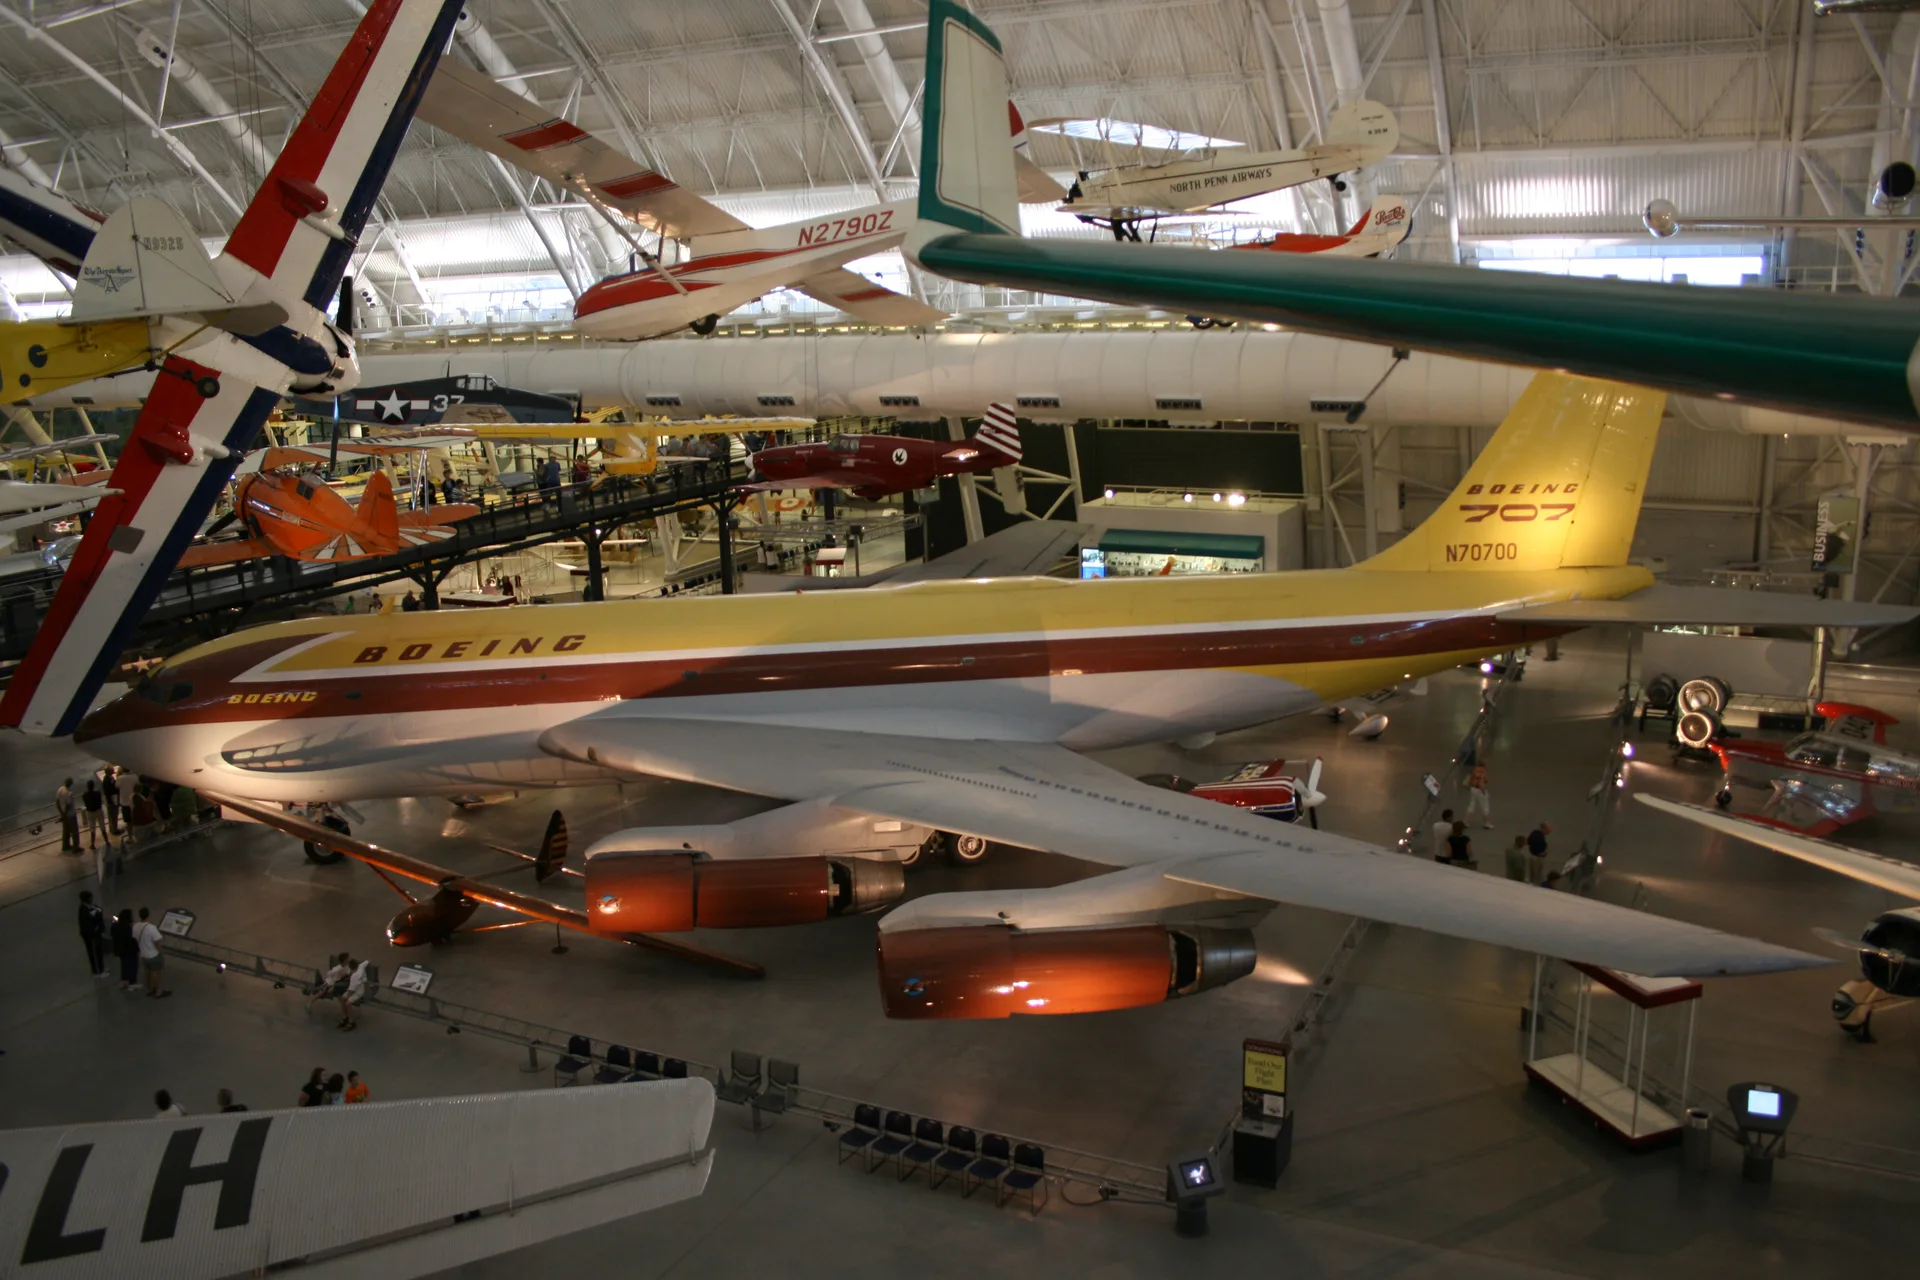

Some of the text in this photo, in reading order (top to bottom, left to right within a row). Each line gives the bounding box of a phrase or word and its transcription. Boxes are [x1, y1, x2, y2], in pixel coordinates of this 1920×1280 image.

[1169, 168, 1272, 193] NORTH PENN AIRWAYS
[797, 210, 894, 246] N2790Z
[143, 237, 184, 250] N9325
[433, 394, 465, 412] 37
[1466, 483, 1578, 495] BOEING
[1459, 503, 1576, 523] 707
[1813, 501, 1829, 562] BUSINESS
[1446, 543, 1517, 562] N70700
[353, 634, 587, 663] BOEING
[227, 691, 318, 704] BOEING
[0, 1117, 273, 1265] LH
